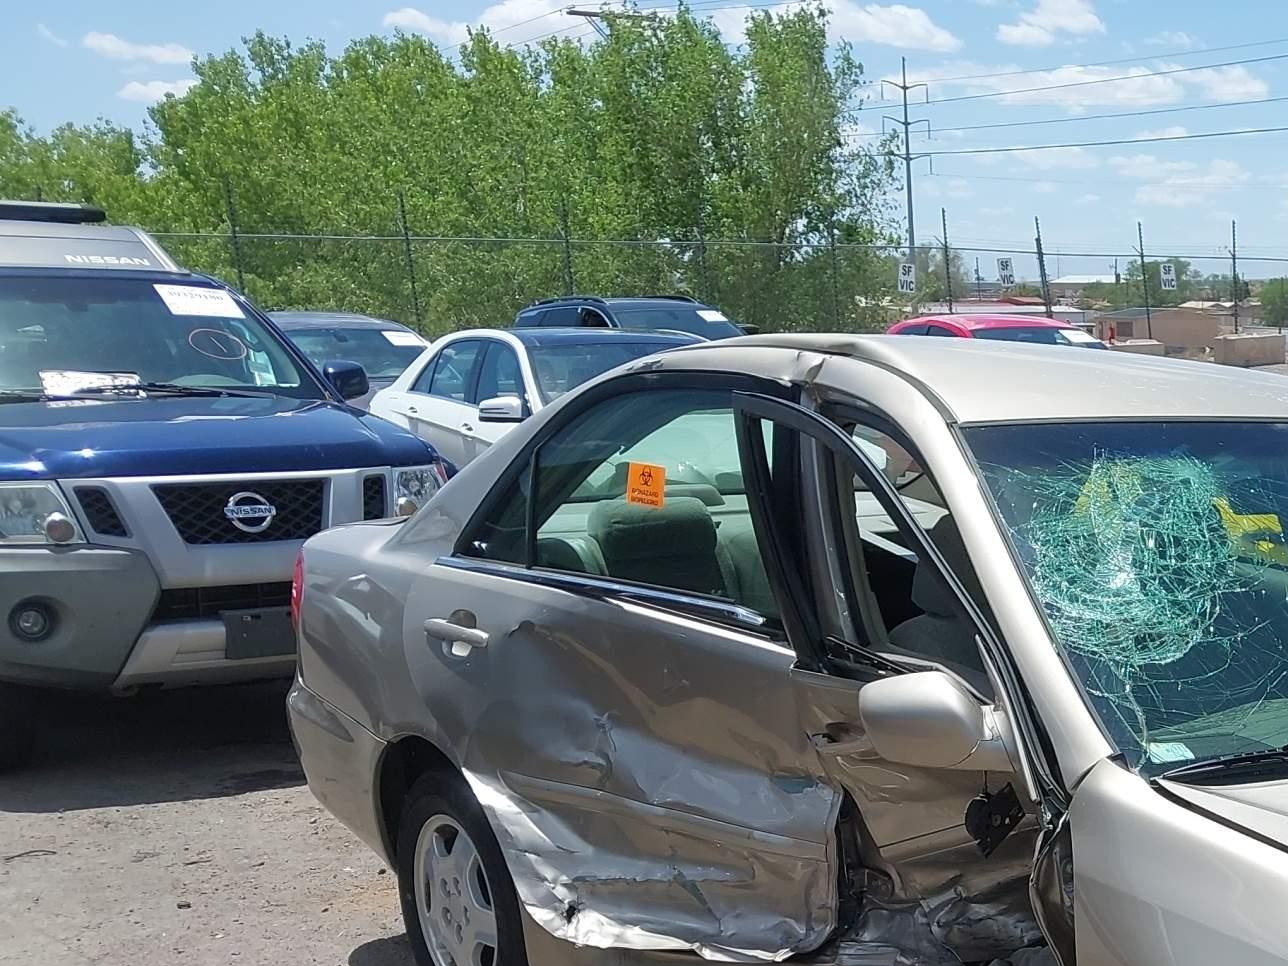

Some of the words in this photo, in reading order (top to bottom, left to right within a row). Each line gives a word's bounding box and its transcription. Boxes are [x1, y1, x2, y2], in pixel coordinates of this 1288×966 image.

[63, 254, 151, 267] NISSAN
[1000, 260, 1011, 272] SF
[901, 264, 913, 277] SF
[1162, 264, 1173, 276] SF
[899, 279, 914, 292] VIC
[1000, 273, 1014, 286] VIC
[1161, 277, 1176, 289] VIC
[230, 506, 272, 516] NISSAN
